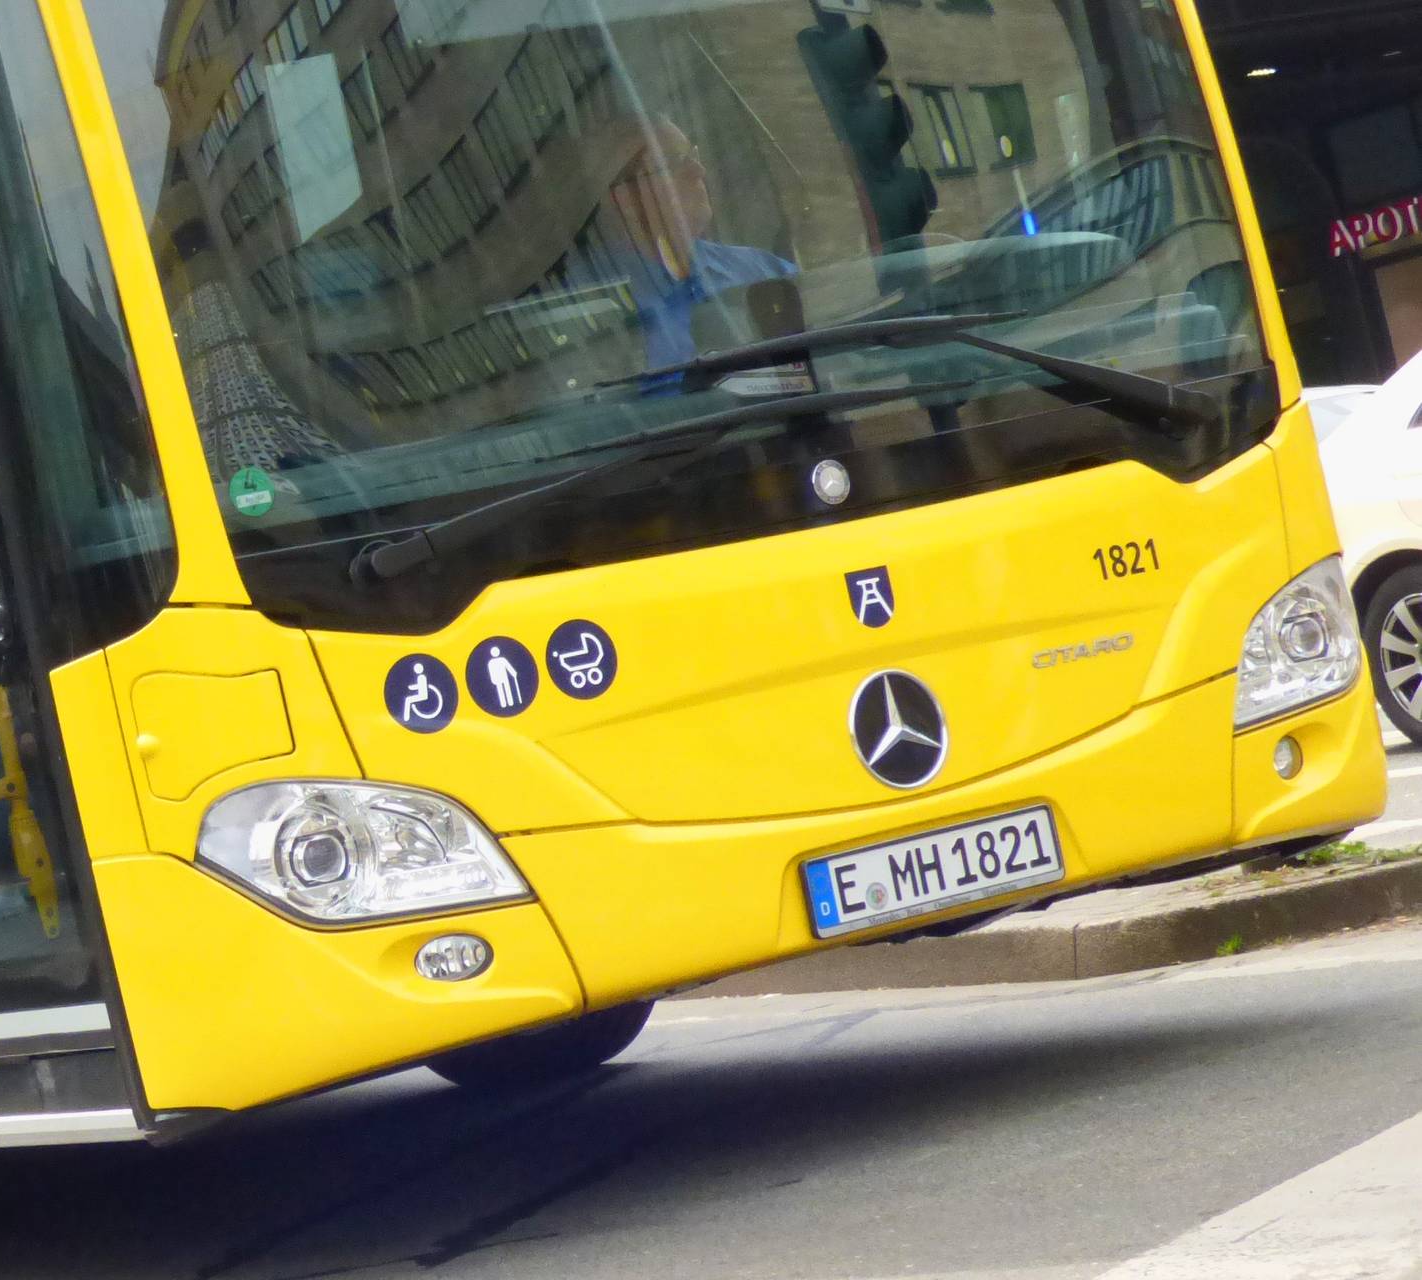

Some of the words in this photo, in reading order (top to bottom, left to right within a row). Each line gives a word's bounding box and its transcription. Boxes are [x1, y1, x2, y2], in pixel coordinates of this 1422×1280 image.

[1330, 196, 1422, 257] APOT
[1092, 538, 1160, 581] 1821
[1032, 632, 1134, 669] CITARO
[834, 863, 867, 915] E
[888, 844, 947, 902] MH
[951, 819, 1053, 887] 1821
